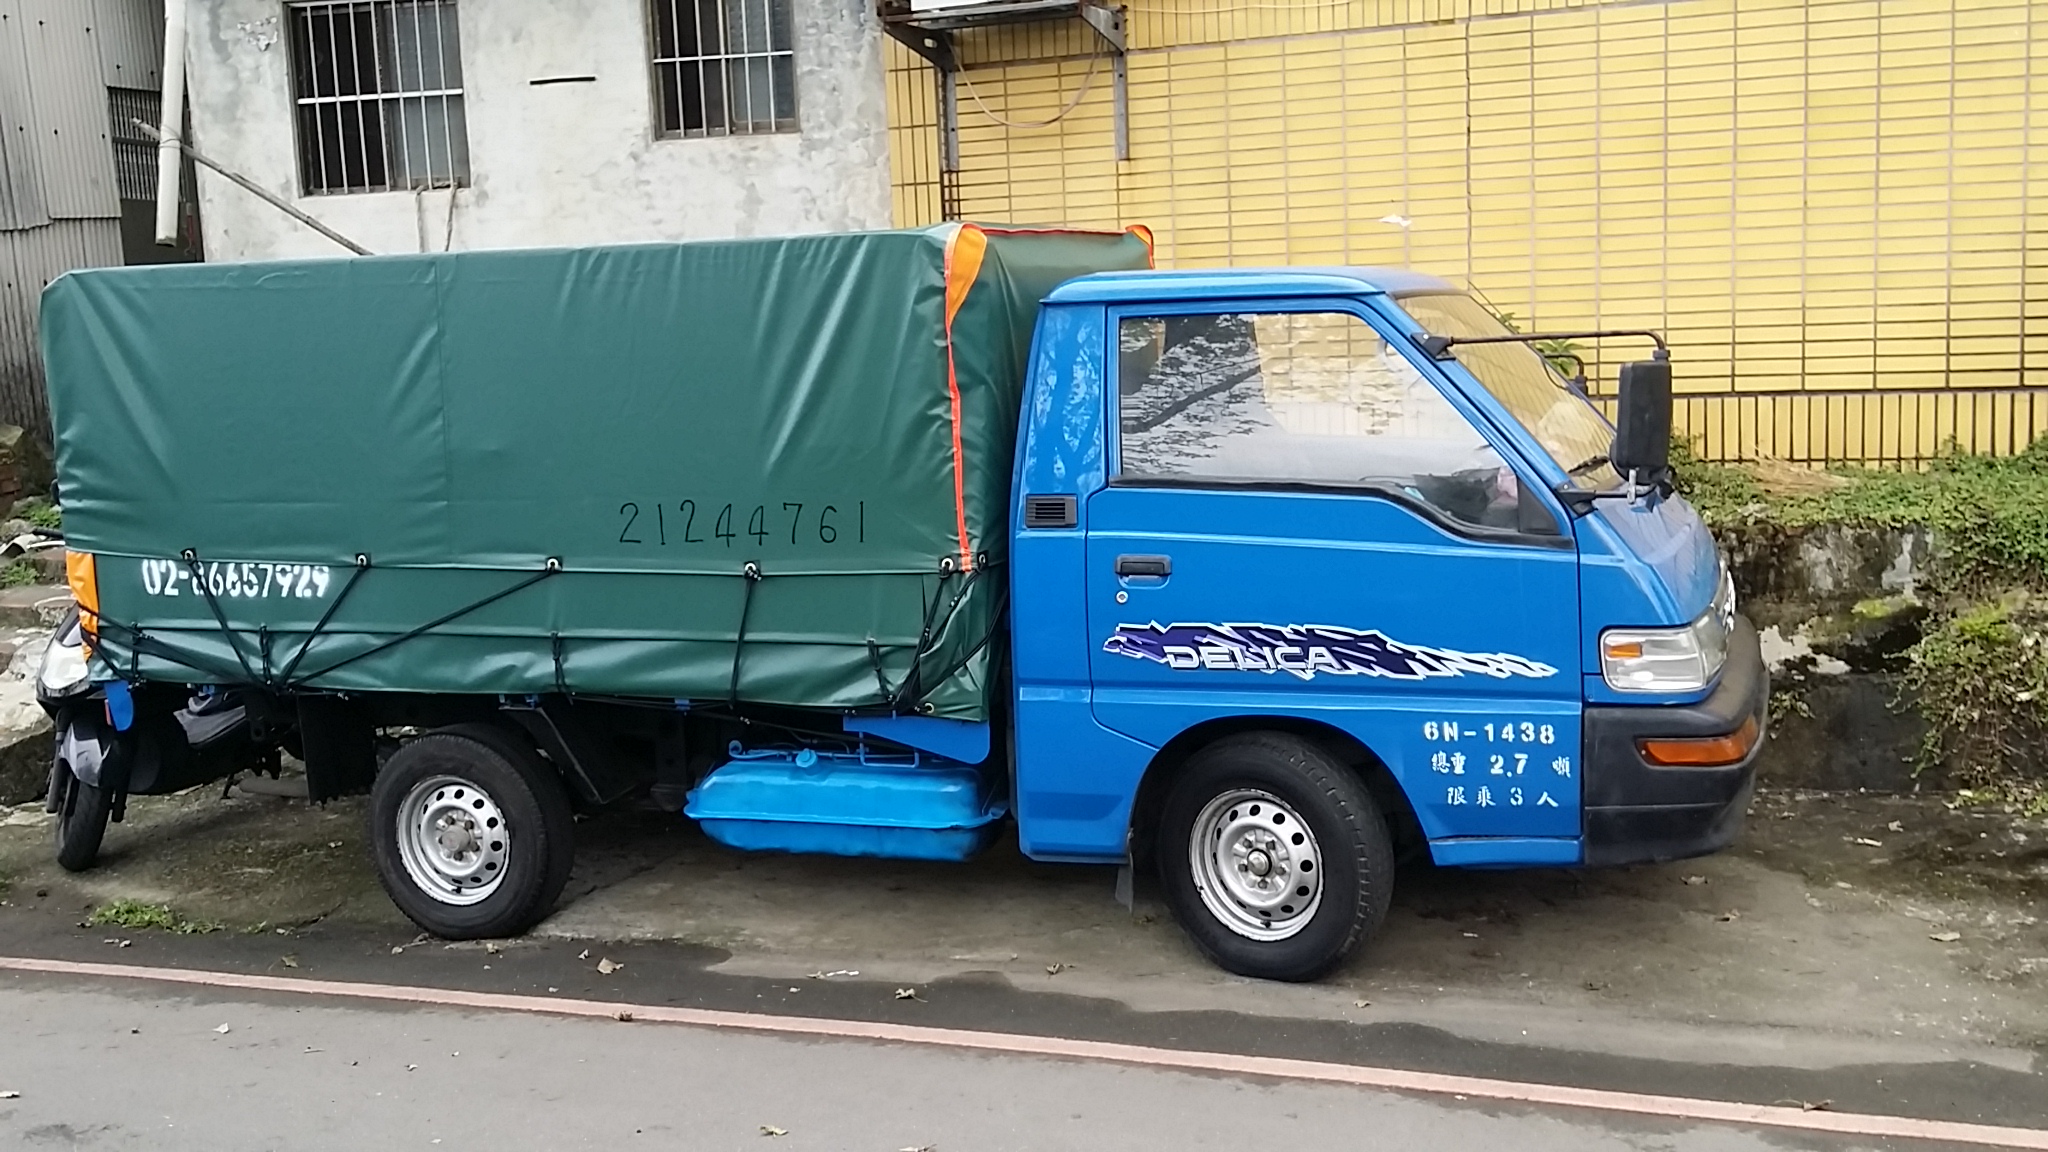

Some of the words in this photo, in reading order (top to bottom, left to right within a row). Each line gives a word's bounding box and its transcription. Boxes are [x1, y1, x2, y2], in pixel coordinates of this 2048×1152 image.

[618, 500, 865, 548] 21244761
[1163, 645, 1340, 670] DELICA
[1424, 721, 1555, 744] 6N-1438
[1431, 751, 1467, 775] 總重
[1490, 753, 1529, 778] 2.7
